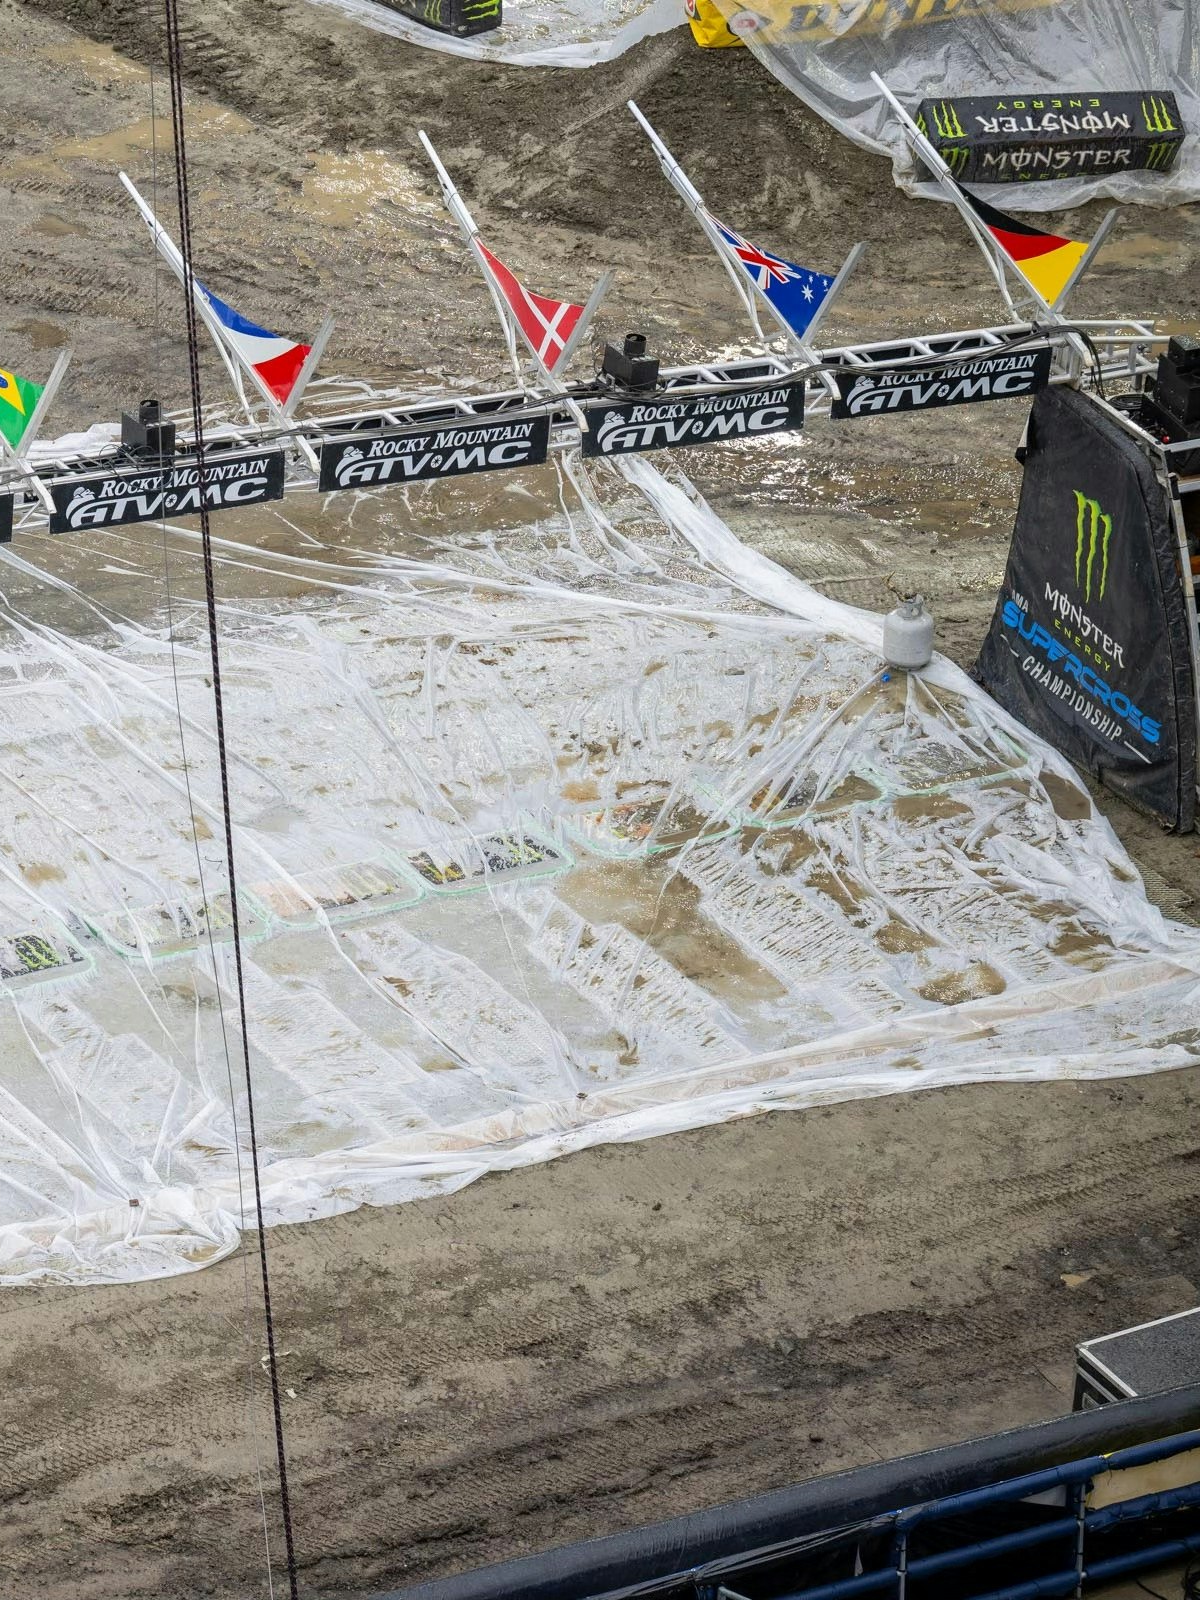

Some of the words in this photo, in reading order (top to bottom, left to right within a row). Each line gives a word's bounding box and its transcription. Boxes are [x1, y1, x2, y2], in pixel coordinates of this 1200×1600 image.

[996, 98, 1101, 110] ENERGY
[629, 403, 689, 424] ROCKY
[692, 387, 792, 416] MOUNTAIN
[367, 436, 431, 459] ROCKY
[431, 423, 534, 450] MOUNTAIN
[99, 475, 164, 499] ROCKY
[165, 458, 270, 489] MOUNTAIN
[1054, 619, 1111, 672] ENERGY
[1002, 600, 1162, 744] SUPERCROSS
[1022, 655, 1123, 741] CHAMPIONSHIP
